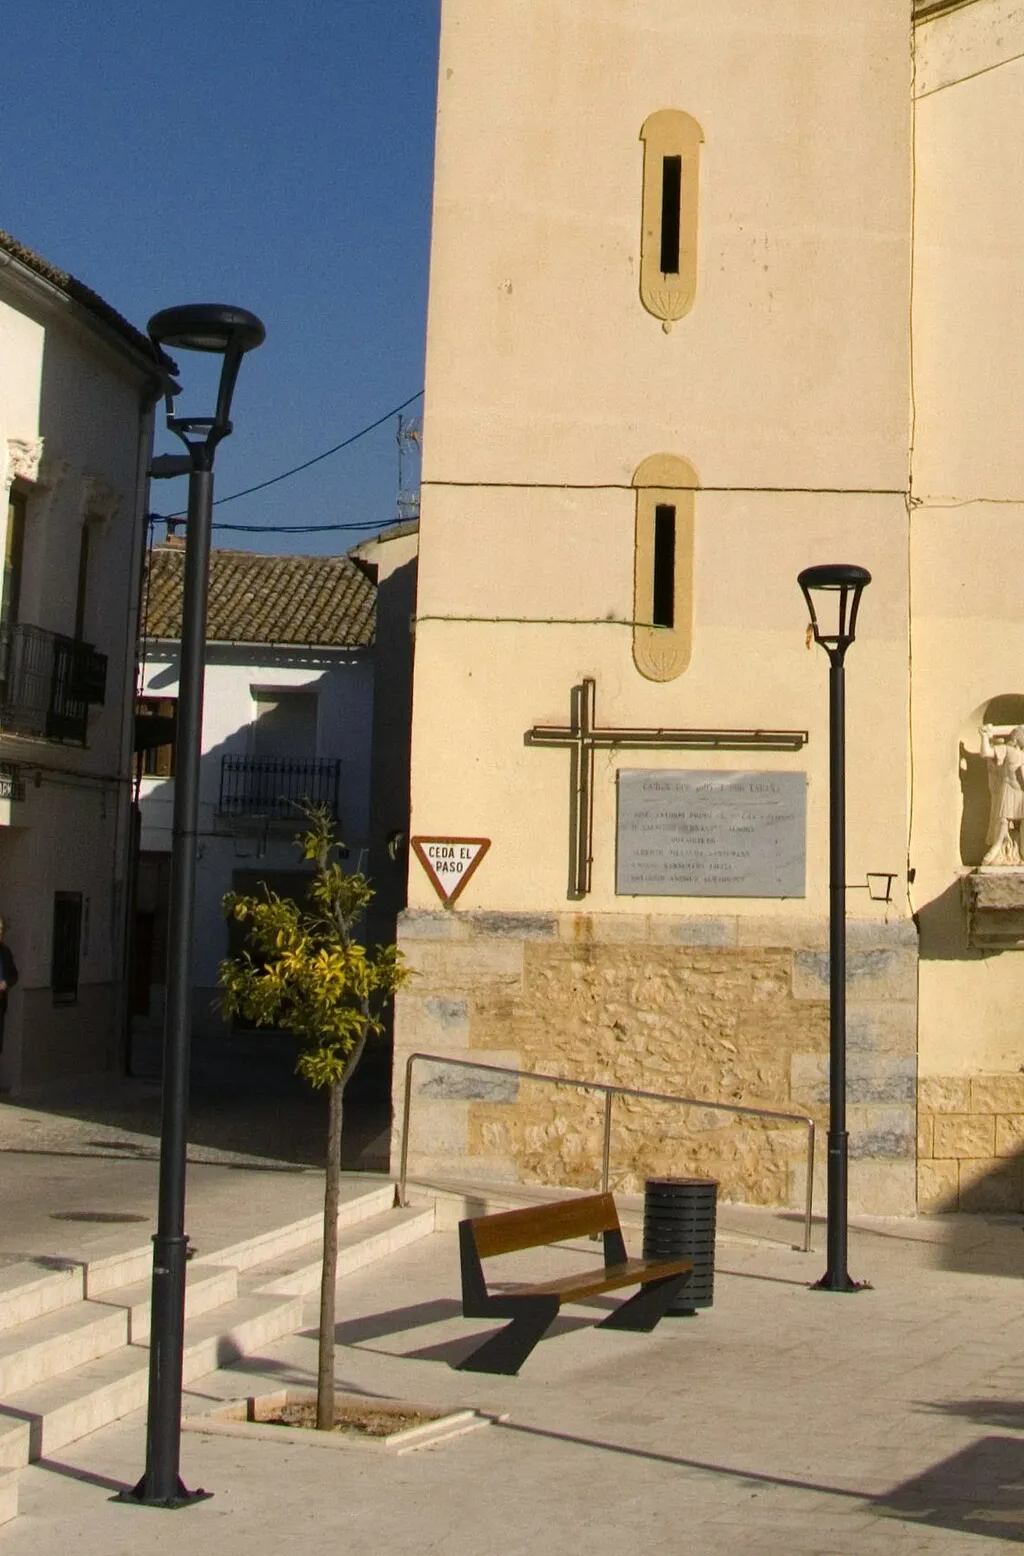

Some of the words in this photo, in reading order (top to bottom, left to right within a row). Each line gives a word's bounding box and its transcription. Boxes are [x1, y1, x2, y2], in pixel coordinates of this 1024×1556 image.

[428, 846, 455, 859] CEDA
[460, 848, 472, 859] EL
[436, 860, 464, 873] PASO
